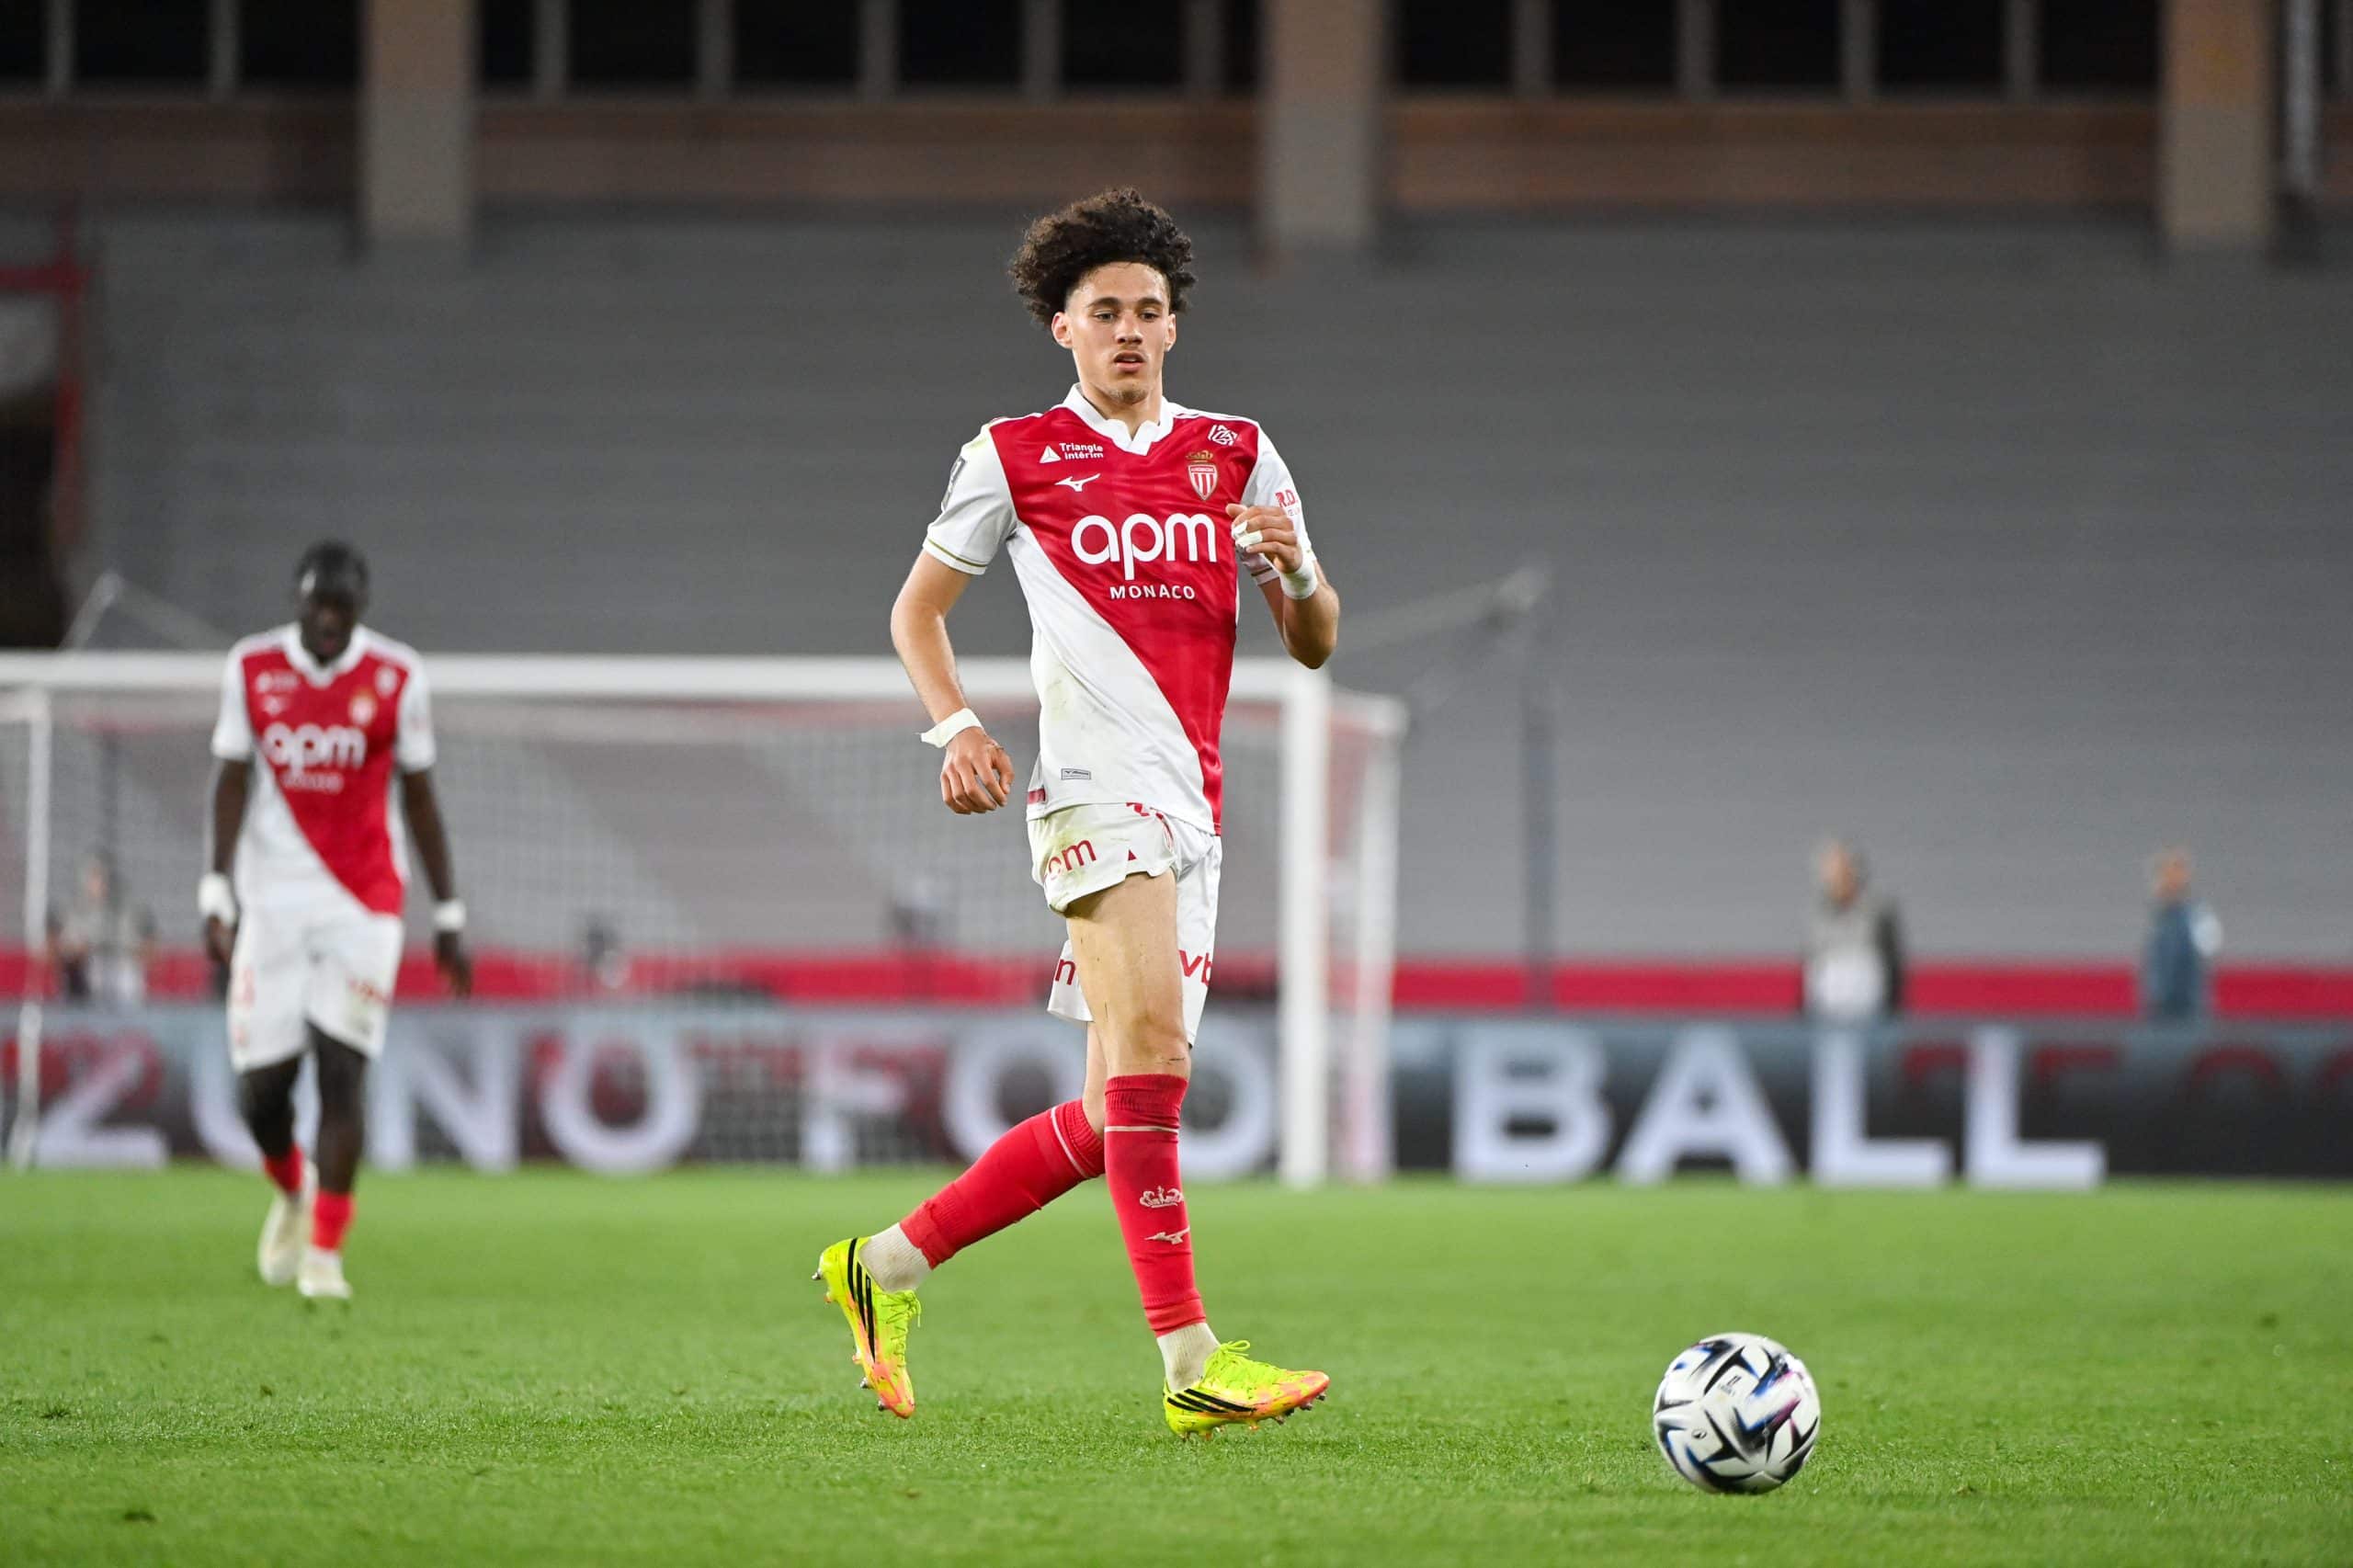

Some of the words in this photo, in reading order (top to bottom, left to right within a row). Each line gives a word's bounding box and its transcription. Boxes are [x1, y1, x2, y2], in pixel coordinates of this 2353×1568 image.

[1059, 442, 1104, 453] Triangle
[1071, 513, 1217, 580] apm
[1109, 585, 1196, 599] MONACO
[263, 722, 366, 778] apm
